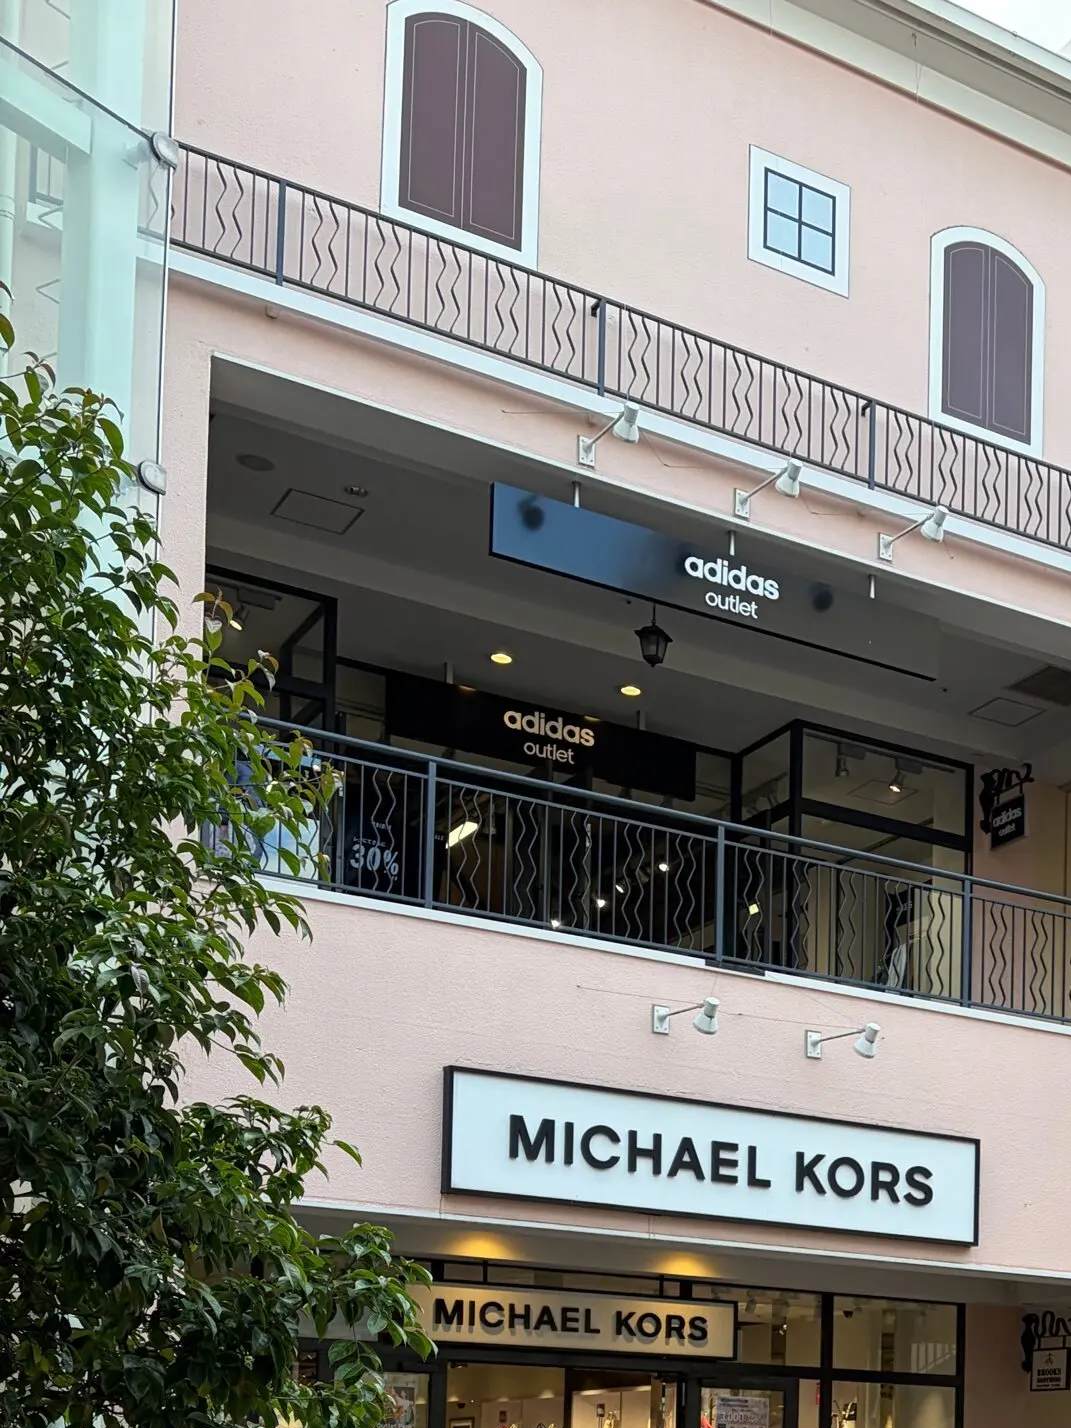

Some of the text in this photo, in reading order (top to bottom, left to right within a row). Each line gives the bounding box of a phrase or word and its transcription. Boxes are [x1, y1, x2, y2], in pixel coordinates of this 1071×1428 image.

[684, 556, 780, 600] adidas
[705, 591, 758, 619] outlet
[503, 710, 595, 747] adidas
[523, 742, 575, 765] outlet
[992, 807, 1022, 828] adidas
[350, 843, 399, 875] 30%
[508, 1103, 934, 1208] MICHAEL KORS
[433, 1298, 708, 1342] MICHAEL KORS
